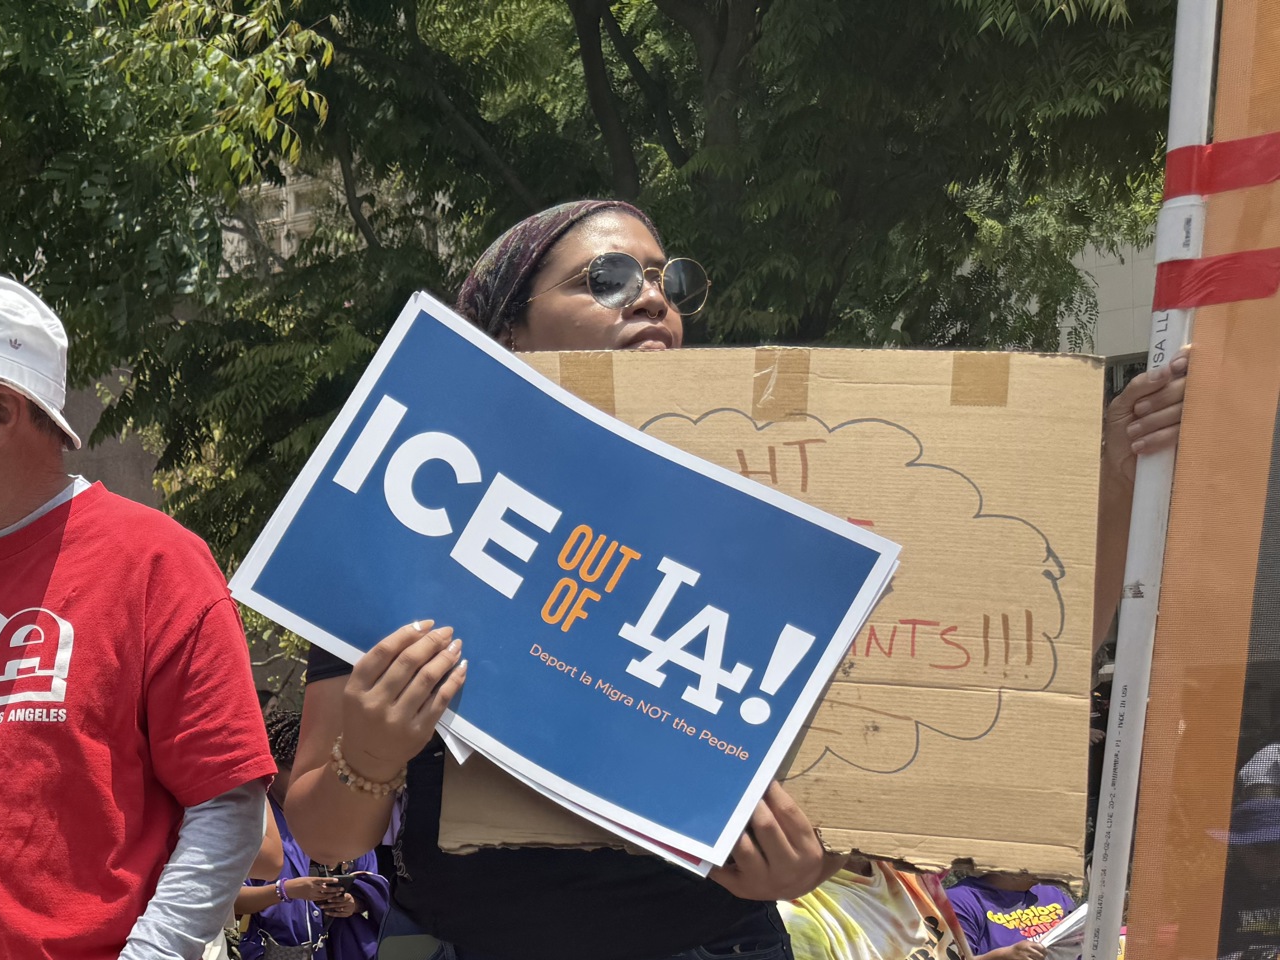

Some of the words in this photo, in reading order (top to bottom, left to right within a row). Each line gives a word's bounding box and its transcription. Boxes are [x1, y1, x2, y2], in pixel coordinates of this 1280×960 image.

[1151, 339, 1167, 370] SA
[1155, 308, 1170, 333] LL
[333, 394, 563, 599] ICE
[557, 524, 641, 592] OUT
[540, 577, 602, 632] OF
[618, 556, 816, 724] LA!
[851, 609, 1033, 679] NTS!!!
[8, 708, 67, 722] ANGELES
[529, 643, 578, 677] Deport
[579, 670, 592, 685] la
[595, 679, 634, 706] Migra
[636, 700, 671, 722] NOT
[673, 717, 696, 736] the
[699, 730, 749, 761] People
